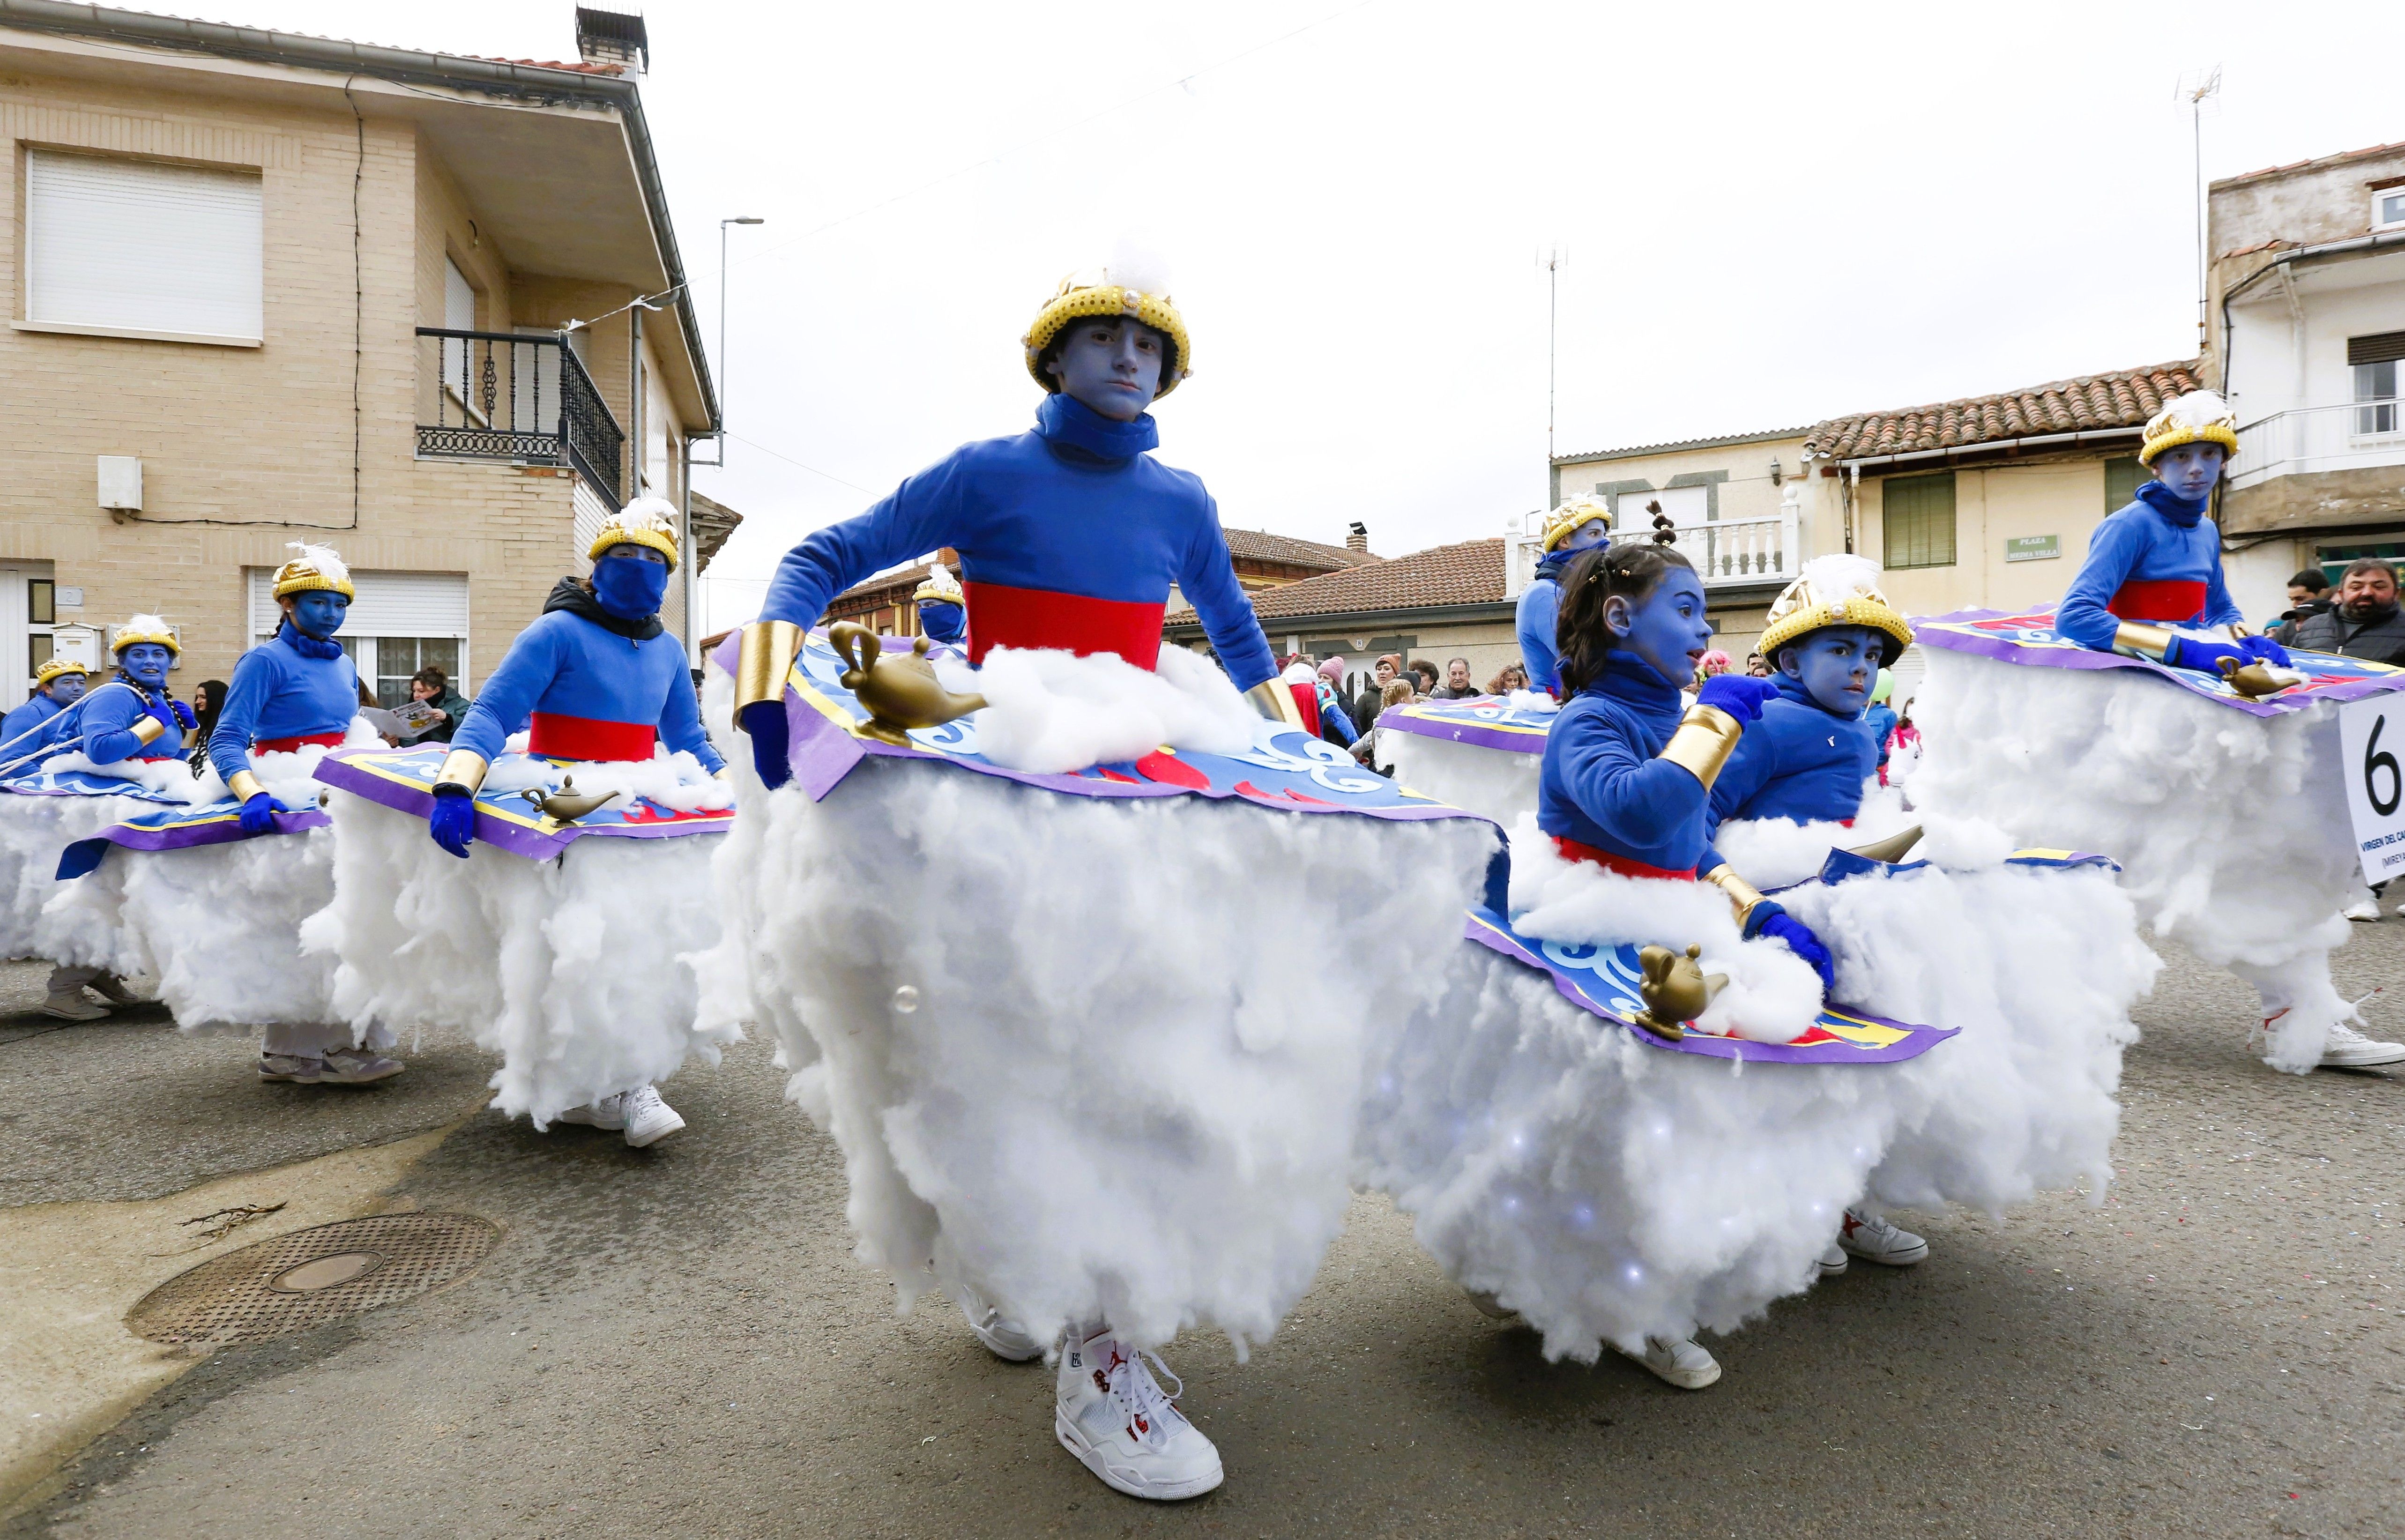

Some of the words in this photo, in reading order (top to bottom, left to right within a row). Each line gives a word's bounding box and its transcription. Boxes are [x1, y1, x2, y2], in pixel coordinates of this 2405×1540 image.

[2020, 537, 2046, 545] PLAZA
[66, 591, 73, 602] 2
[2365, 714, 2402, 816] 6
[2360, 837, 2384, 852] VIRGEN
[2384, 834, 2396, 844] DEL
